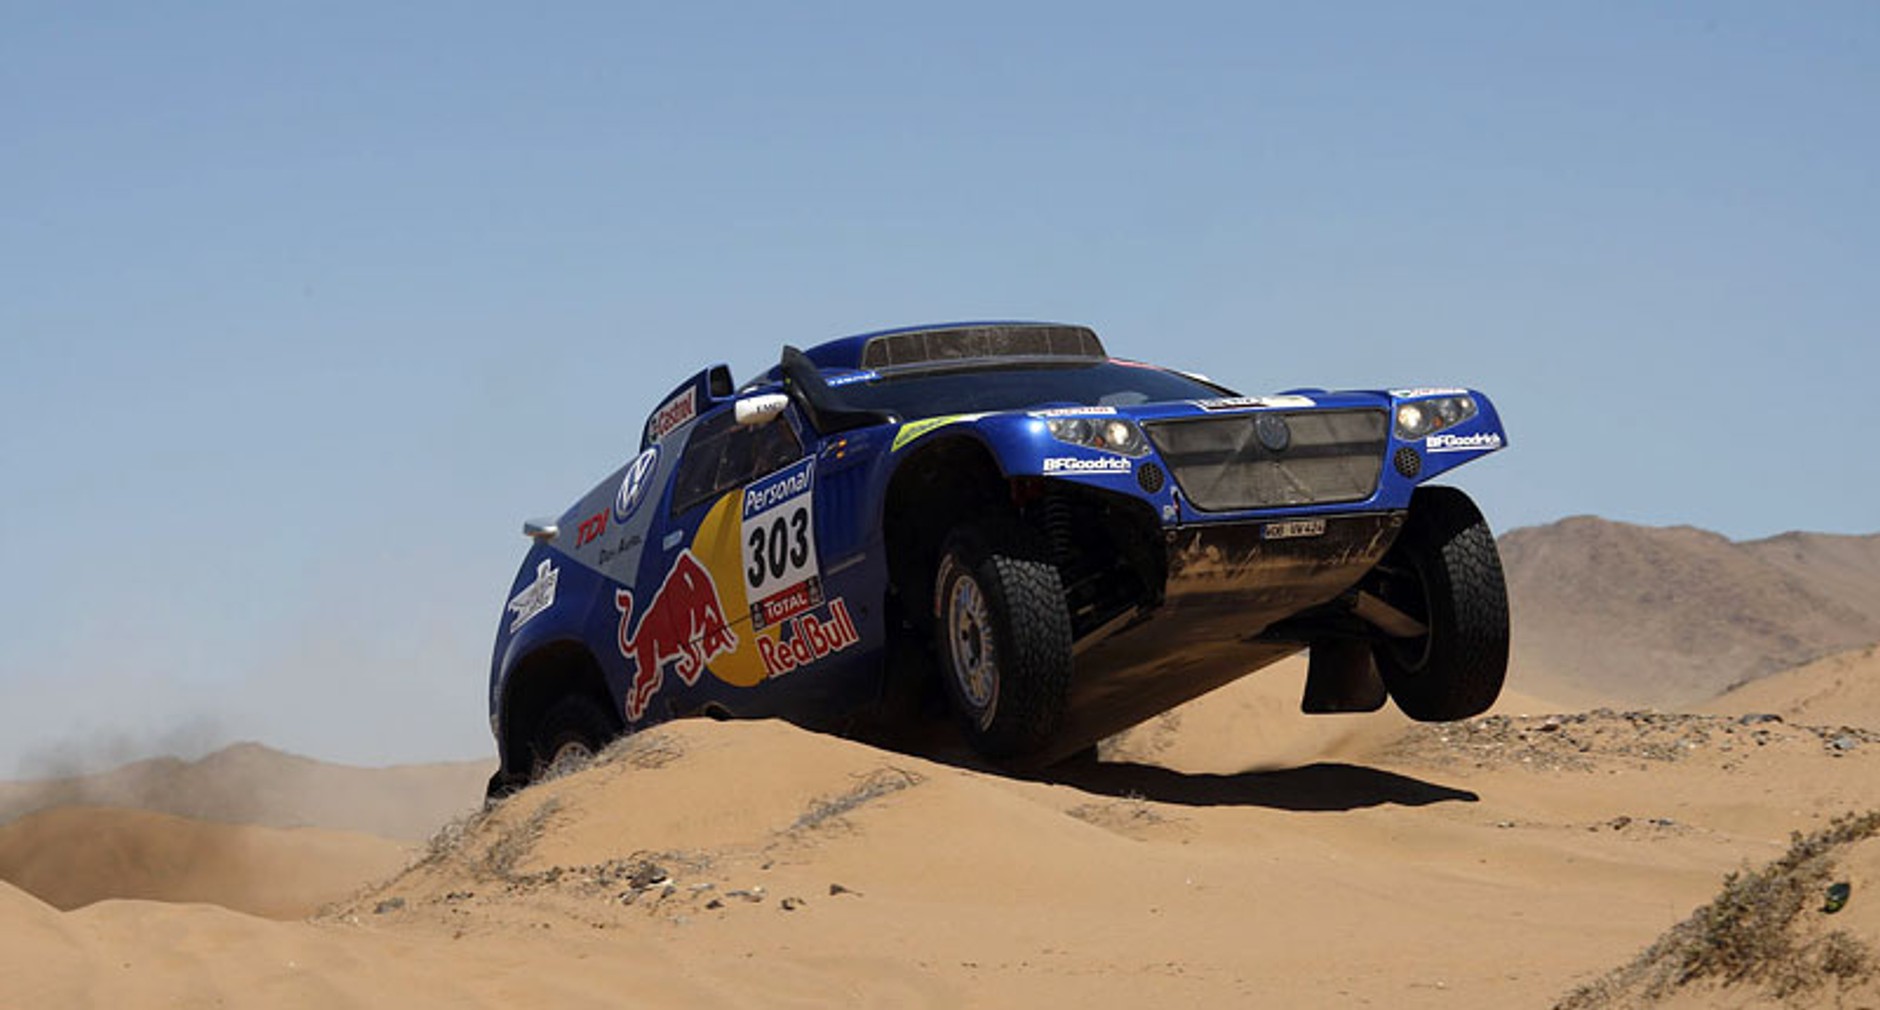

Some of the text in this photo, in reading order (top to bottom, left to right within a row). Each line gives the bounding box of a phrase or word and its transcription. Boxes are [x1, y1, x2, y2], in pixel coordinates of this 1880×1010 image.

[655, 390, 693, 436] Castrol
[1426, 432, 1501, 453] BFGoodrich
[1043, 457, 1131, 475] BFGoodrich
[744, 462, 815, 516] Personal
[576, 507, 610, 548] TDI
[747, 506, 809, 588] 303
[764, 591, 808, 618] TOTAL
[757, 597, 859, 678] Red Bull
